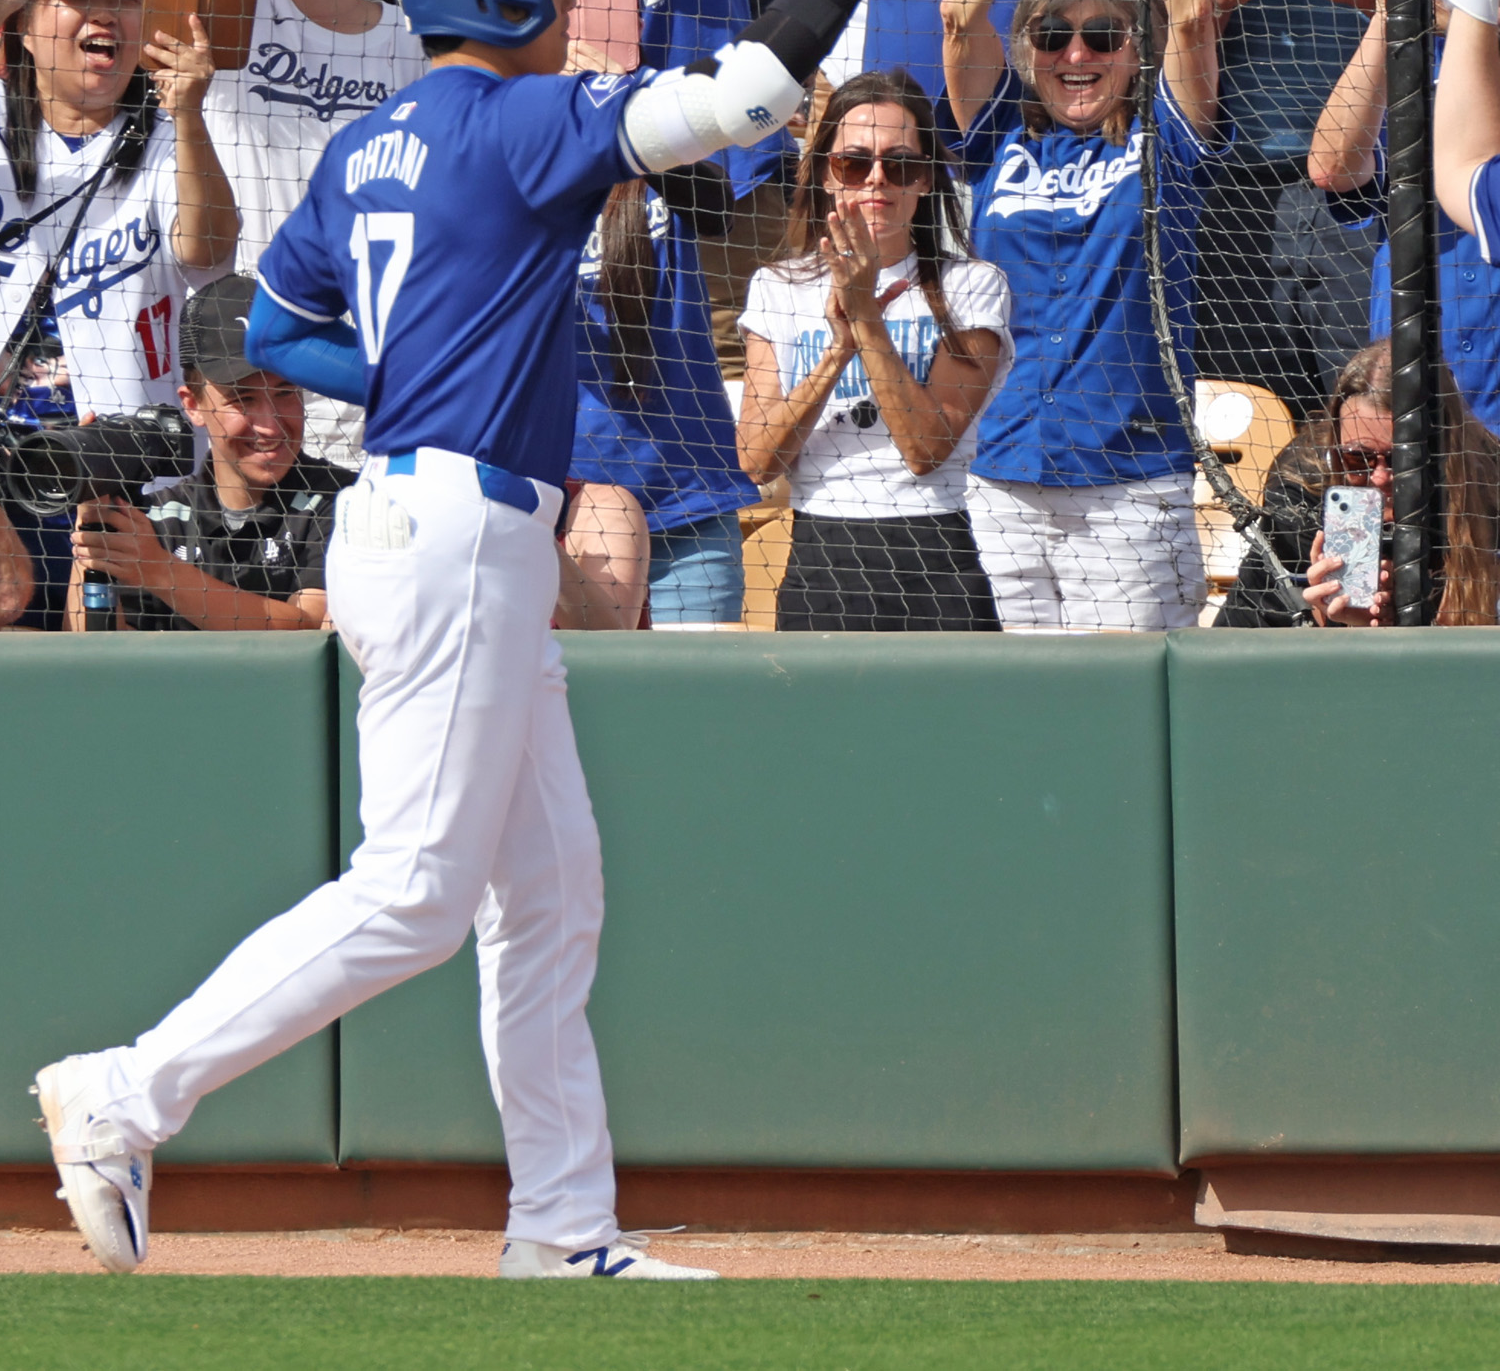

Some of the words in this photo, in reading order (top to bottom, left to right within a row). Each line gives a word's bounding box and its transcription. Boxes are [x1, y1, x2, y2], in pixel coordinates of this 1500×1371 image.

[249, 42, 388, 122] Dodgers
[346, 129, 428, 194] OHTANI
[349, 212, 415, 365] 17
[135, 294, 172, 381] 17
